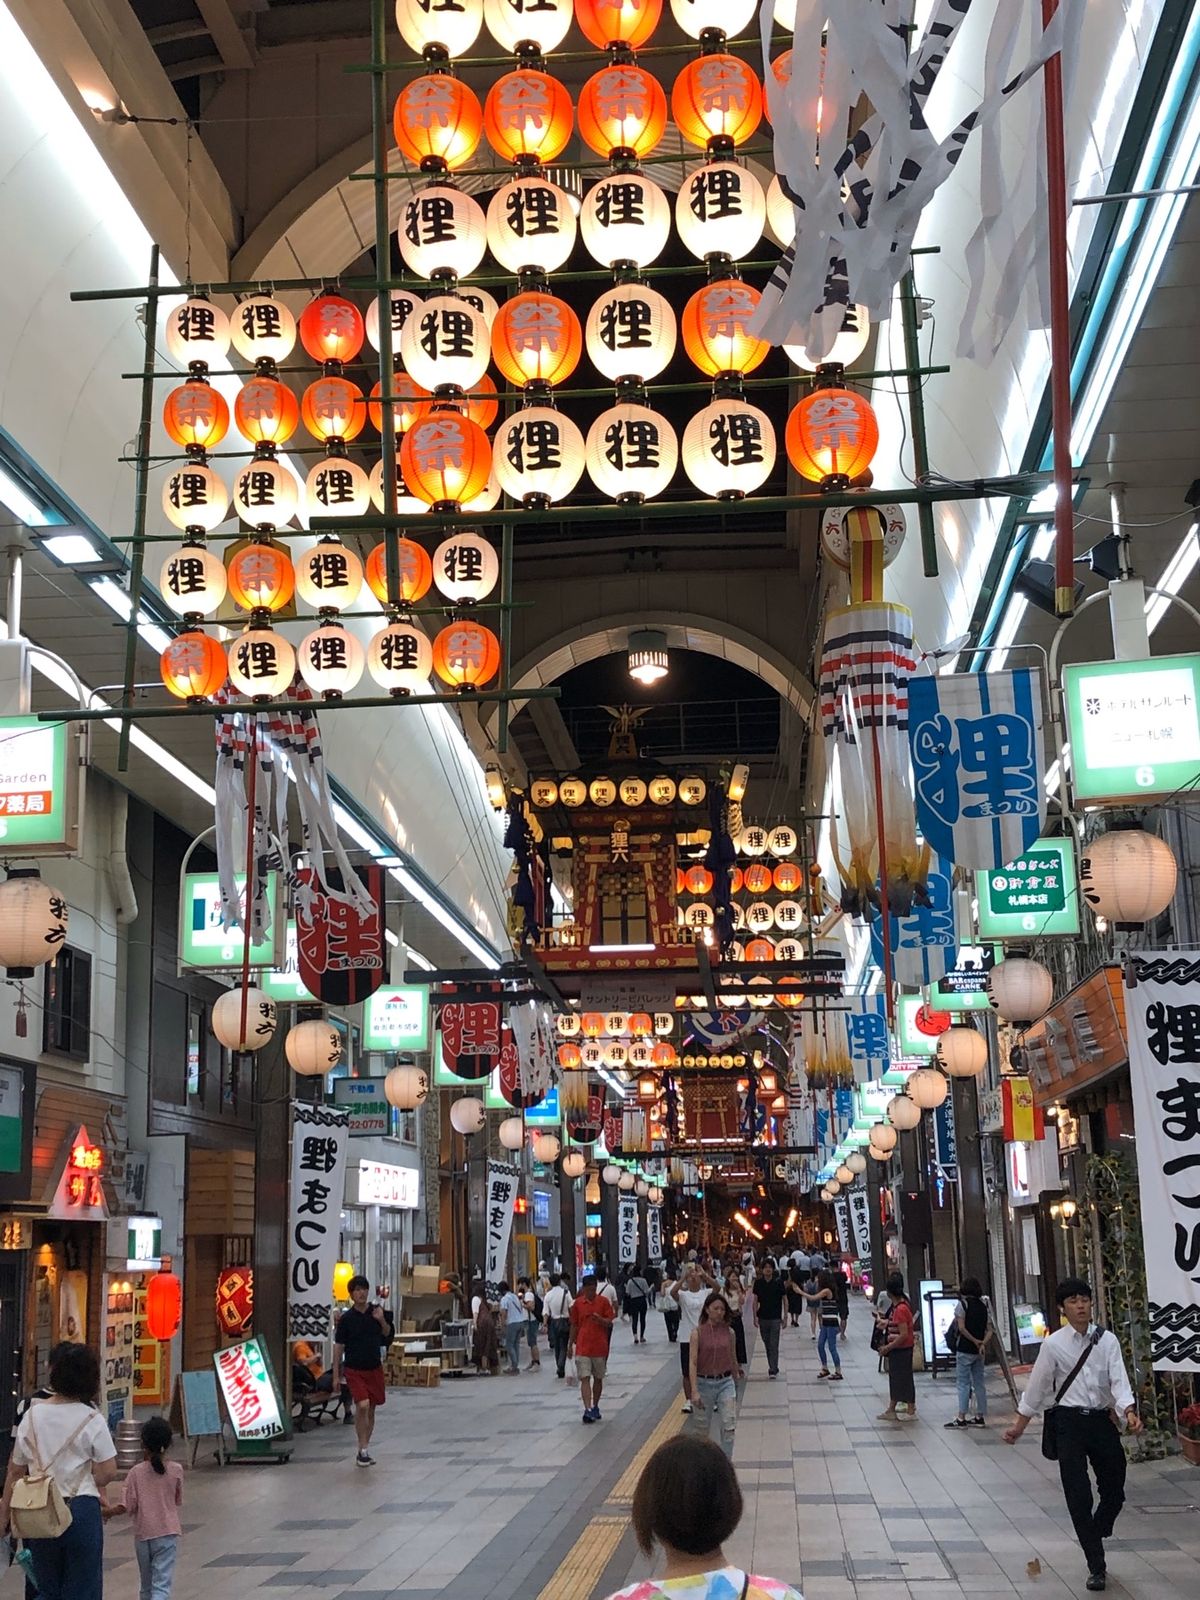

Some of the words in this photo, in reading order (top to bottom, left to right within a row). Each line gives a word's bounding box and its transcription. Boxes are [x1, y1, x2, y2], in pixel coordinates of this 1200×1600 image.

[406, 78, 458, 130] 祭
[501, 77, 547, 129] 祭
[597, 72, 648, 122] 祭
[696, 60, 748, 113] 祭
[506, 186, 559, 238] 狸
[595, 182, 645, 228] 狸
[689, 170, 742, 223] 狸
[405, 196, 458, 247] 狸
[178, 305, 215, 342] 狸
[242, 303, 281, 341] 狸
[420, 308, 474, 362] 狸
[510, 302, 560, 353] 祭
[599, 299, 653, 352] 狸
[709, 412, 764, 467] 狸
[807, 397, 859, 451] 祭
[413, 420, 465, 474] 祭
[506, 419, 561, 474] 狸
[604, 419, 660, 472] 狸
[169, 472, 207, 508] 狸
[239, 471, 275, 508] 狸
[316, 470, 354, 506] 狸
[168, 558, 207, 595] 狸
[310, 553, 348, 589] 狸
[445, 545, 482, 582] 狸
[238, 641, 278, 679] 狸
[310, 636, 347, 670] 狸
[380, 634, 419, 669] 狸
[914, 713, 1035, 825] 狸
[1135, 766, 1155, 787] 6
[979, 801, 1032, 815] まつり
[610, 832, 629, 863] 狸六
[748, 831, 764, 847] 狸
[775, 832, 791, 848] 狸
[1008, 894, 1048, 905] 札幌本店
[1022, 915, 1036, 931] 6
[442, 1002, 499, 1057] 狸
[349, 1102, 387, 1114] 都市開発
